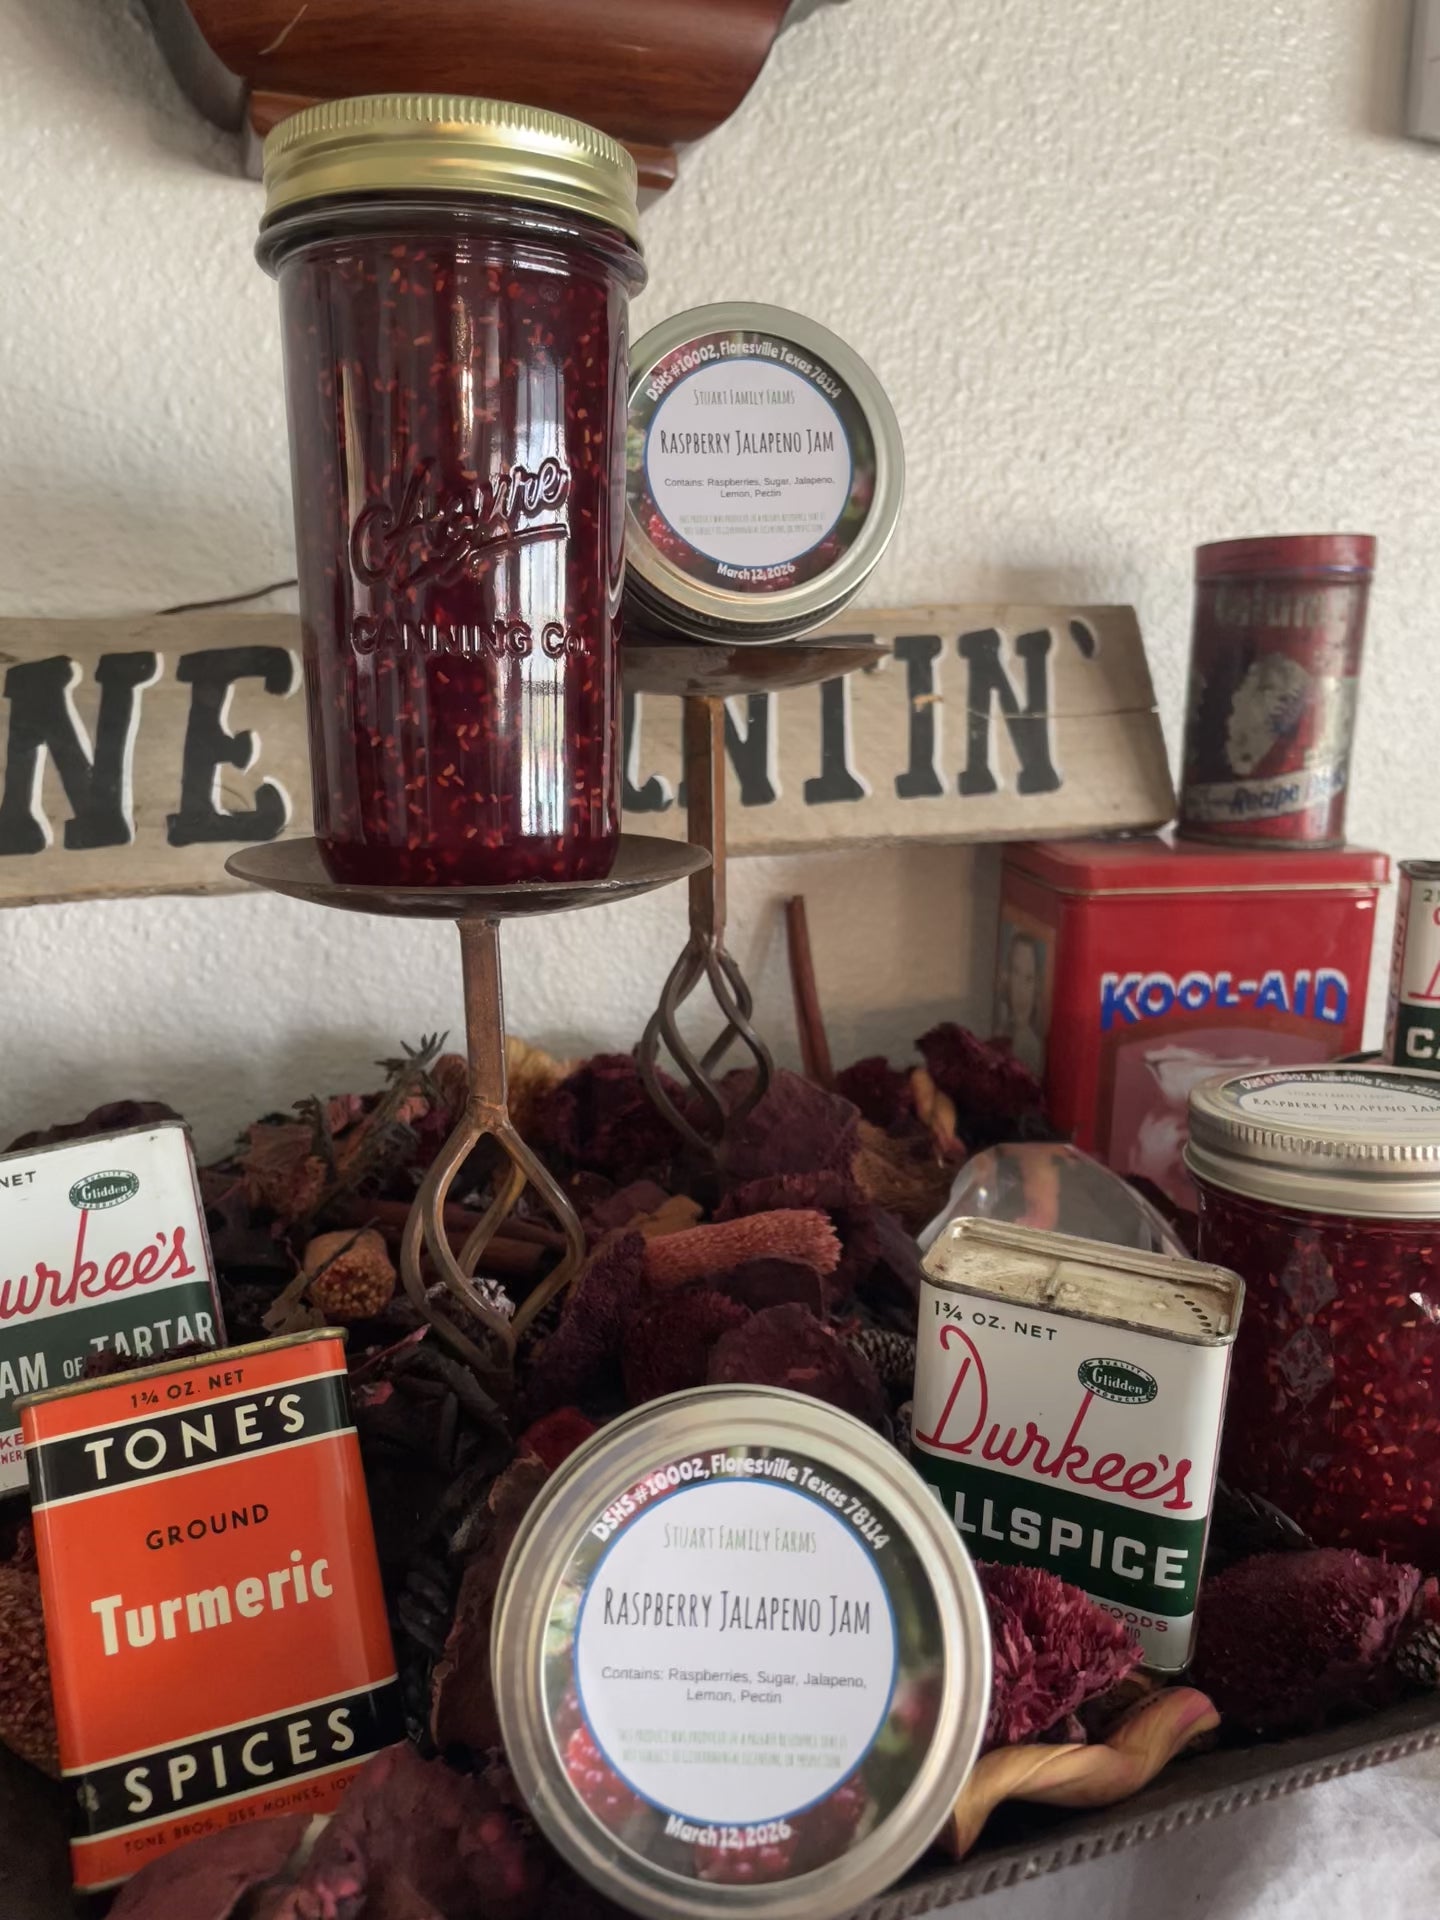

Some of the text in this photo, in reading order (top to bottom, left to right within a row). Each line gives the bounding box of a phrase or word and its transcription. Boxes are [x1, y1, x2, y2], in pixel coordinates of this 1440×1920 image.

[645, 370, 673, 402] DSHS
[720, 341, 779, 359] Floresville
[780, 346, 813, 375] Texas
[660, 428, 835, 456] RASPBERRY JALAPENO JAM
[664, 475, 835, 488] Contains: Raspberries, Sugar, Jalapeno,
[754, 489, 782, 499] Pectin
[716, 563, 750, 580] March
[767, 564, 795, 576] 2026
[352, 615, 532, 660] CANNING
[1099, 968, 1350, 1032] KOOL-AID
[0, 1170, 37, 1188] NET
[81, 1184, 128, 1201] Glidden
[972, 1312, 1006, 1331] OZ.
[1014, 1320, 1057, 1341] NET
[63, 1356, 84, 1380] OF
[90, 1311, 217, 1358] TARTAR
[167, 1381, 200, 1400] OZ.
[208, 1369, 244, 1391] NET
[1092, 1367, 1143, 1395] Glidden
[915, 1325, 1193, 1510] Durkee's
[84, 1393, 306, 1481] TONE'S
[591, 1453, 891, 1550] DSHS #10002, Floresville Texas 78114
[145, 1504, 270, 1550] GROUND
[91, 1550, 334, 1656] Turmeric
[604, 1587, 871, 1637] RASPBERRY JALAPENO JAM
[601, 1666, 868, 1690] Contains: Raspberries, Sugar, Jalapeno,
[686, 1688, 783, 1704] Lemon, Pectin
[124, 1707, 356, 1813] SPICES
[664, 1813, 718, 1848] March
[744, 1819, 792, 1848] 2026
